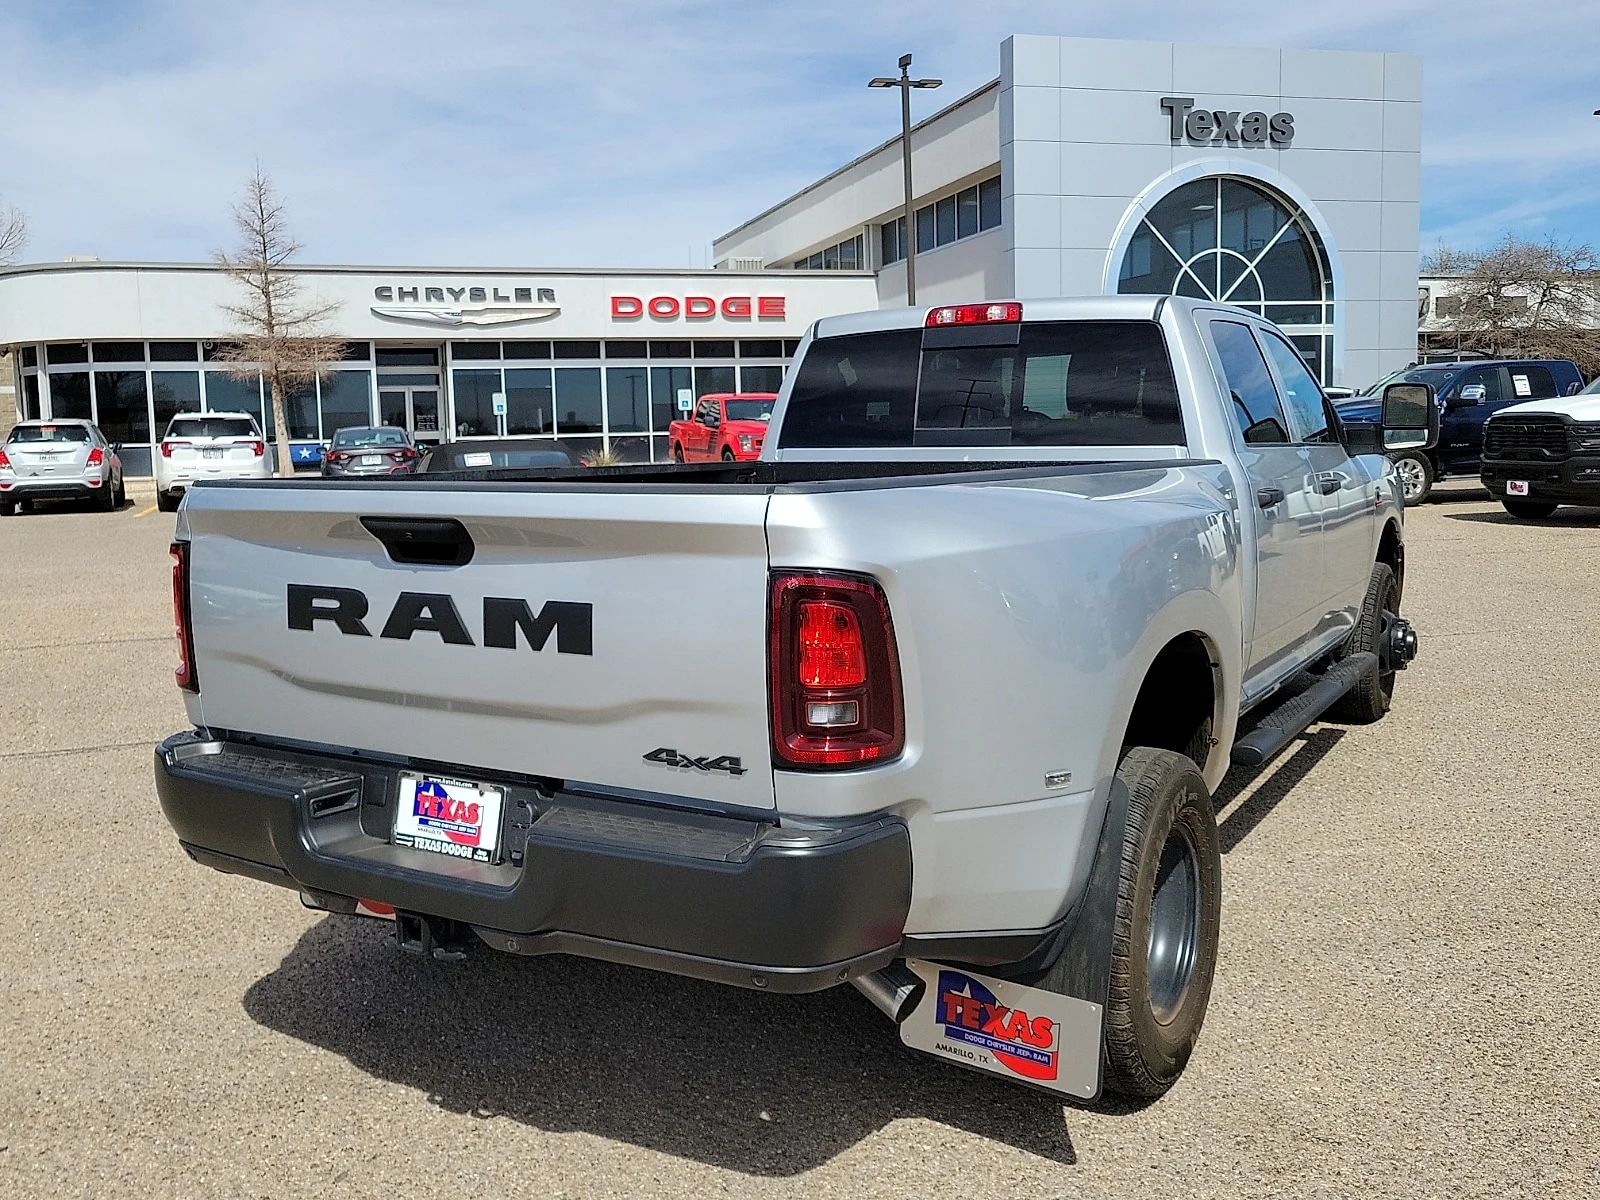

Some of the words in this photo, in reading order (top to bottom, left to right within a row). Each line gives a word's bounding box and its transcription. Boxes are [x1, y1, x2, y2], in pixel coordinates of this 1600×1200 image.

[1160, 97, 1295, 143] Texas
[374, 285, 557, 303] CHRYSLER
[611, 296, 786, 319] DODGE
[287, 583, 593, 656] RAM
[417, 793, 479, 824] TEXAS
[414, 836, 442, 853] TEXAS
[442, 842, 473, 859] DODGE
[943, 992, 1053, 1048] TEXAS
[964, 1033, 986, 1045] DODGE
[986, 1039, 1016, 1054] CHRYSLER
[1033, 1053, 1049, 1063] RAM
[979, 1054, 989, 1064] TX
